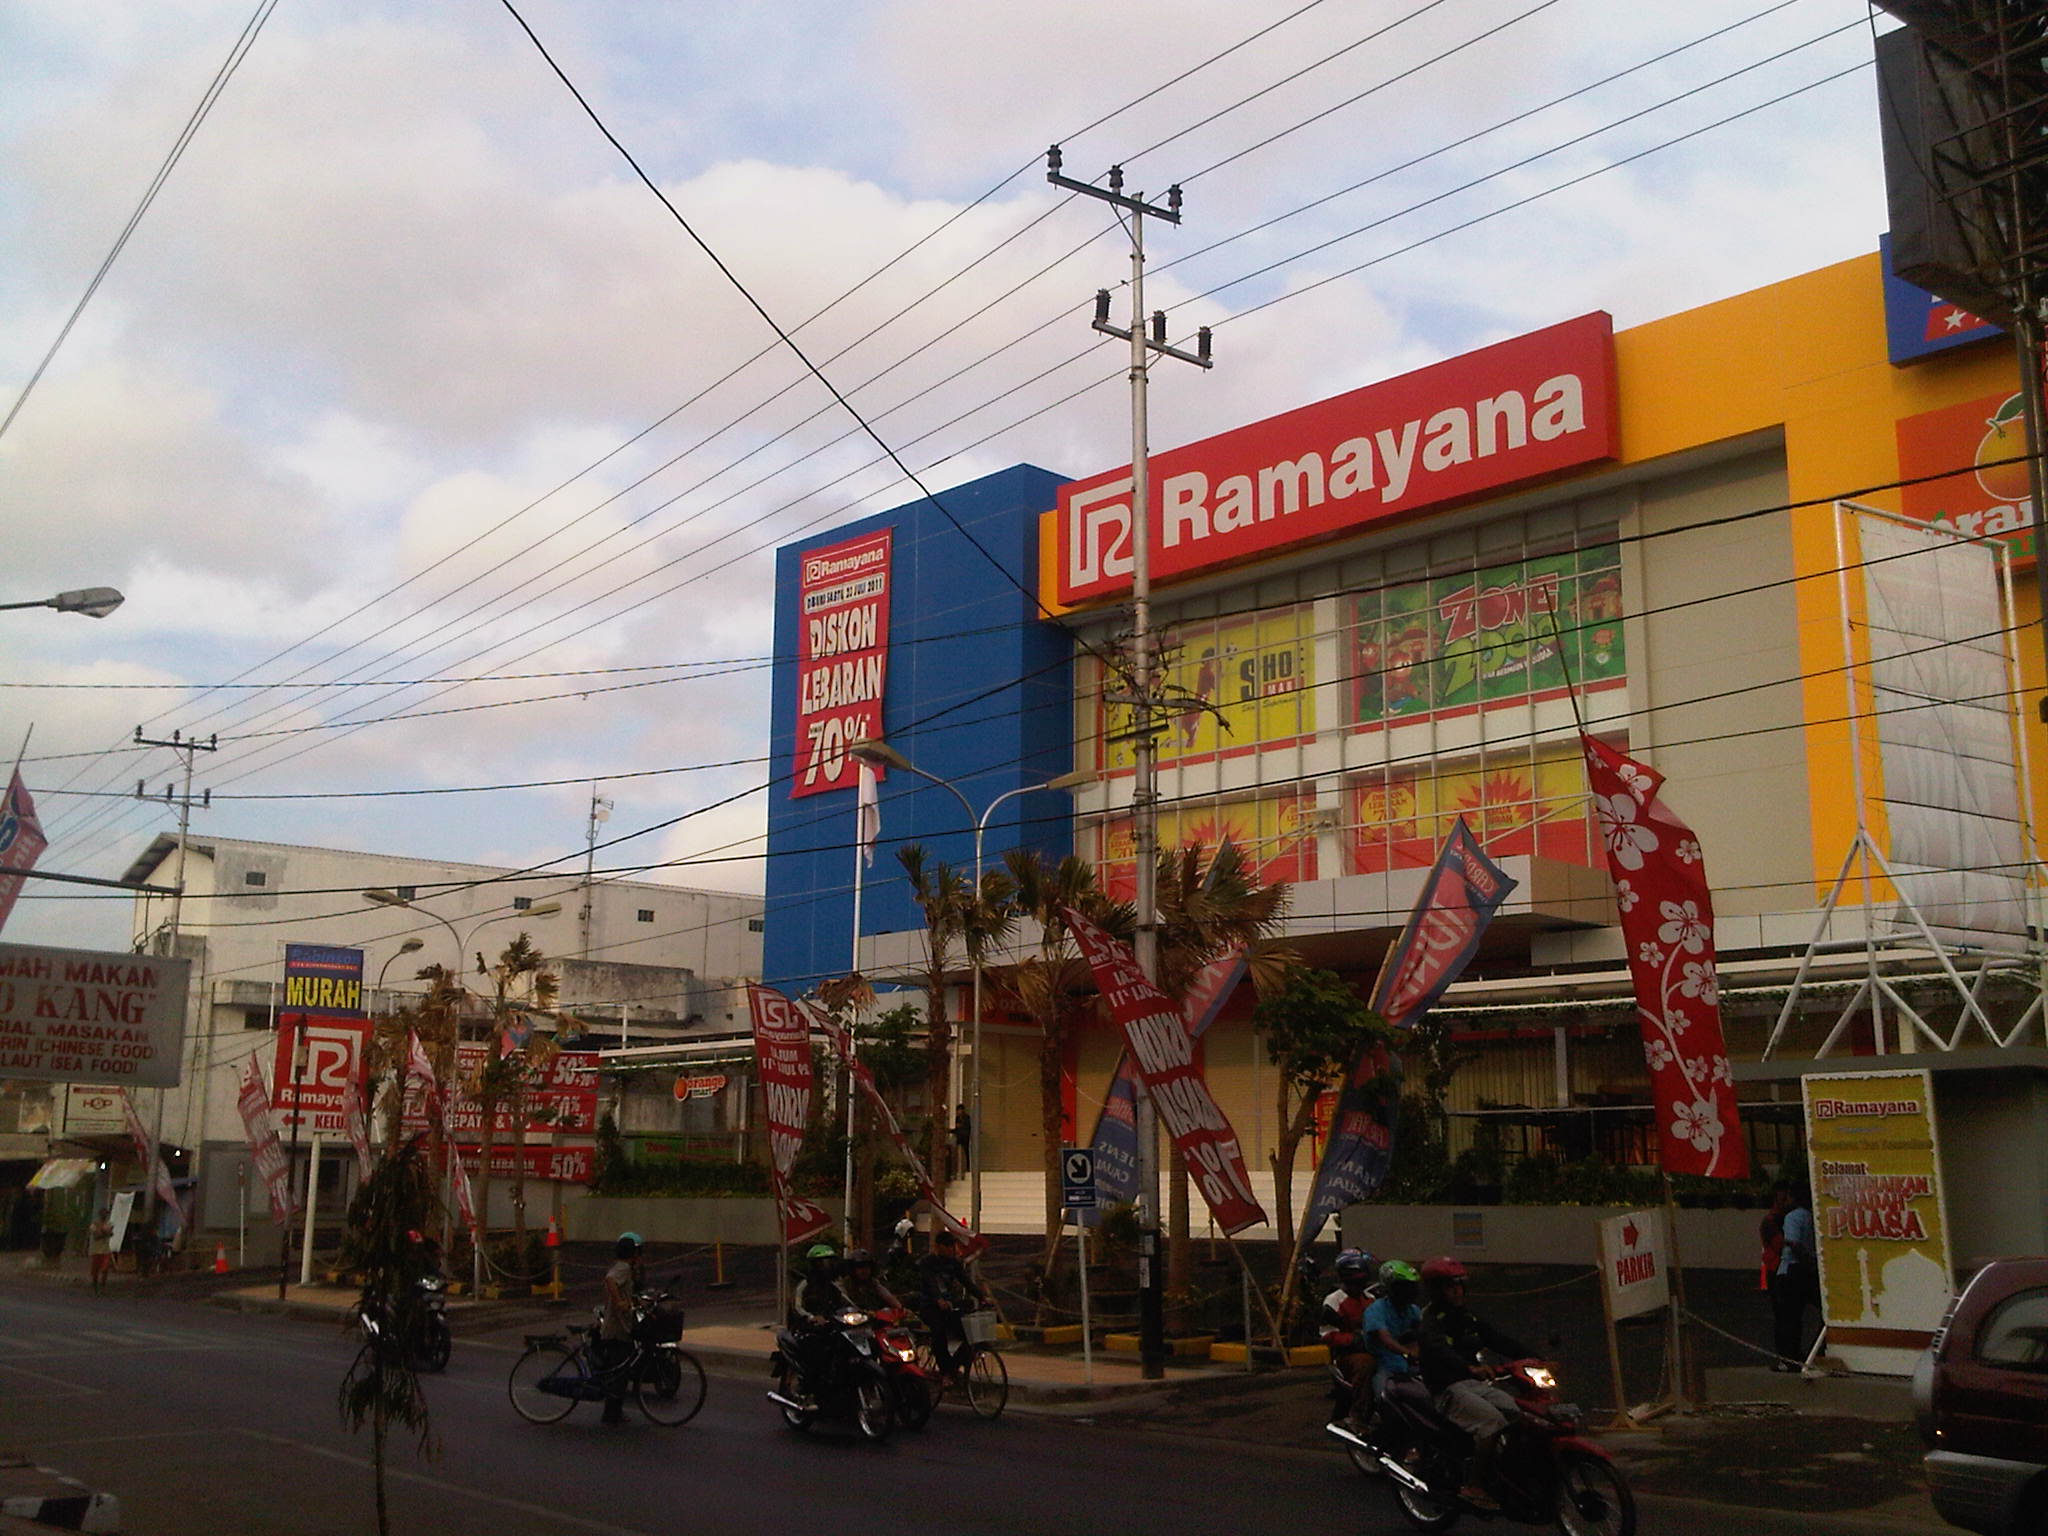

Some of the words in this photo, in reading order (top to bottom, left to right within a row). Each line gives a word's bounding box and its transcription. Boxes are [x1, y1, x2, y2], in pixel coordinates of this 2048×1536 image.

[1163, 373, 1587, 549] Ramayana
[820, 548, 883, 577] Ramayana
[868, 577, 882, 593] 2011
[1440, 572, 1559, 645] ZONE
[809, 603, 878, 662] DISKON
[1444, 614, 1561, 696] 2000
[801, 654, 884, 716] LEBARAN
[1241, 648, 1305, 702] SHO
[65, 962, 160, 989] MAKAN
[286, 975, 361, 1010] MURAH
[47, 1022, 149, 1043] MASAKAN
[1, 1051, 43, 1069] LAUT
[494, 1114, 506, 1129] &
[1833, 1100, 1918, 1116] Ramayana
[549, 1151, 586, 1179] 50%
[1821, 1161, 1866, 1176] Selamat
[1827, 1207, 1924, 1239] PUASA
[1616, 1252, 1655, 1287] PARKIR
